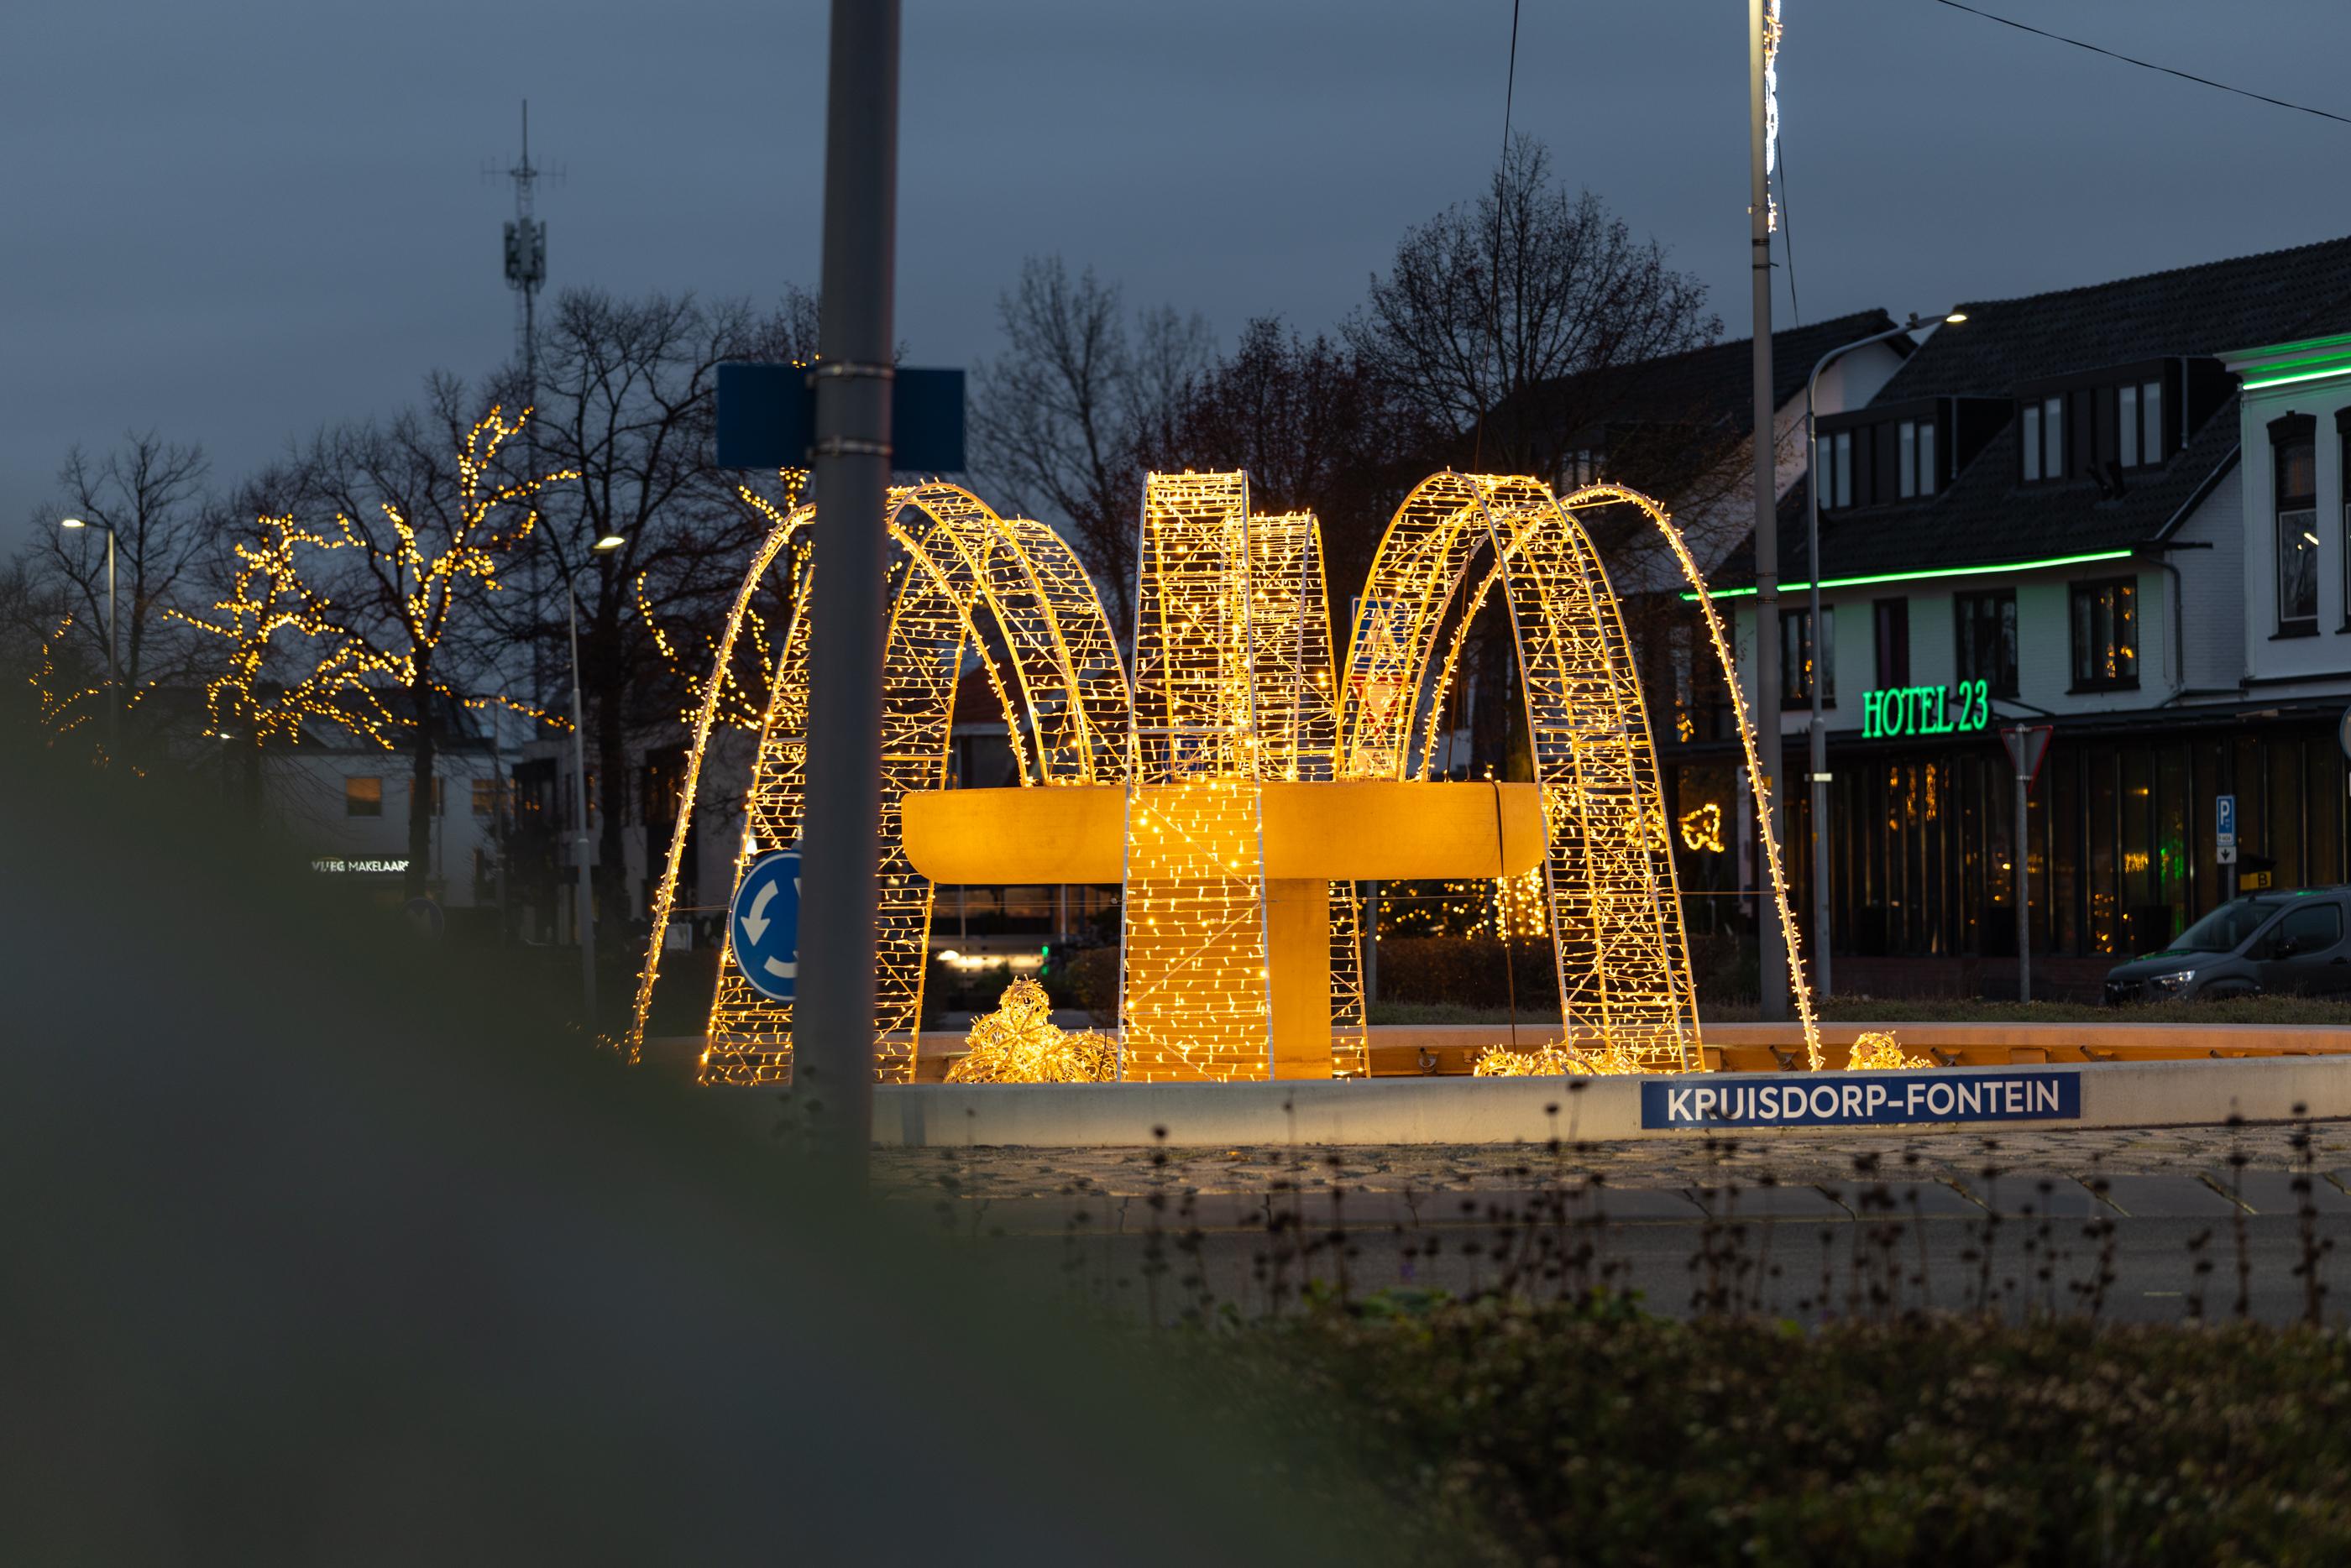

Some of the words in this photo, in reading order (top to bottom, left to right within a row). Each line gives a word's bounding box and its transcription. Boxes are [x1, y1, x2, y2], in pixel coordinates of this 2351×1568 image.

[1861, 685, 1954, 738] HOTEL
[1958, 678, 1989, 731] 23
[2220, 799, 2230, 825] P
[1667, 1079, 2060, 1121] KRUISDORP-FONTEIN
